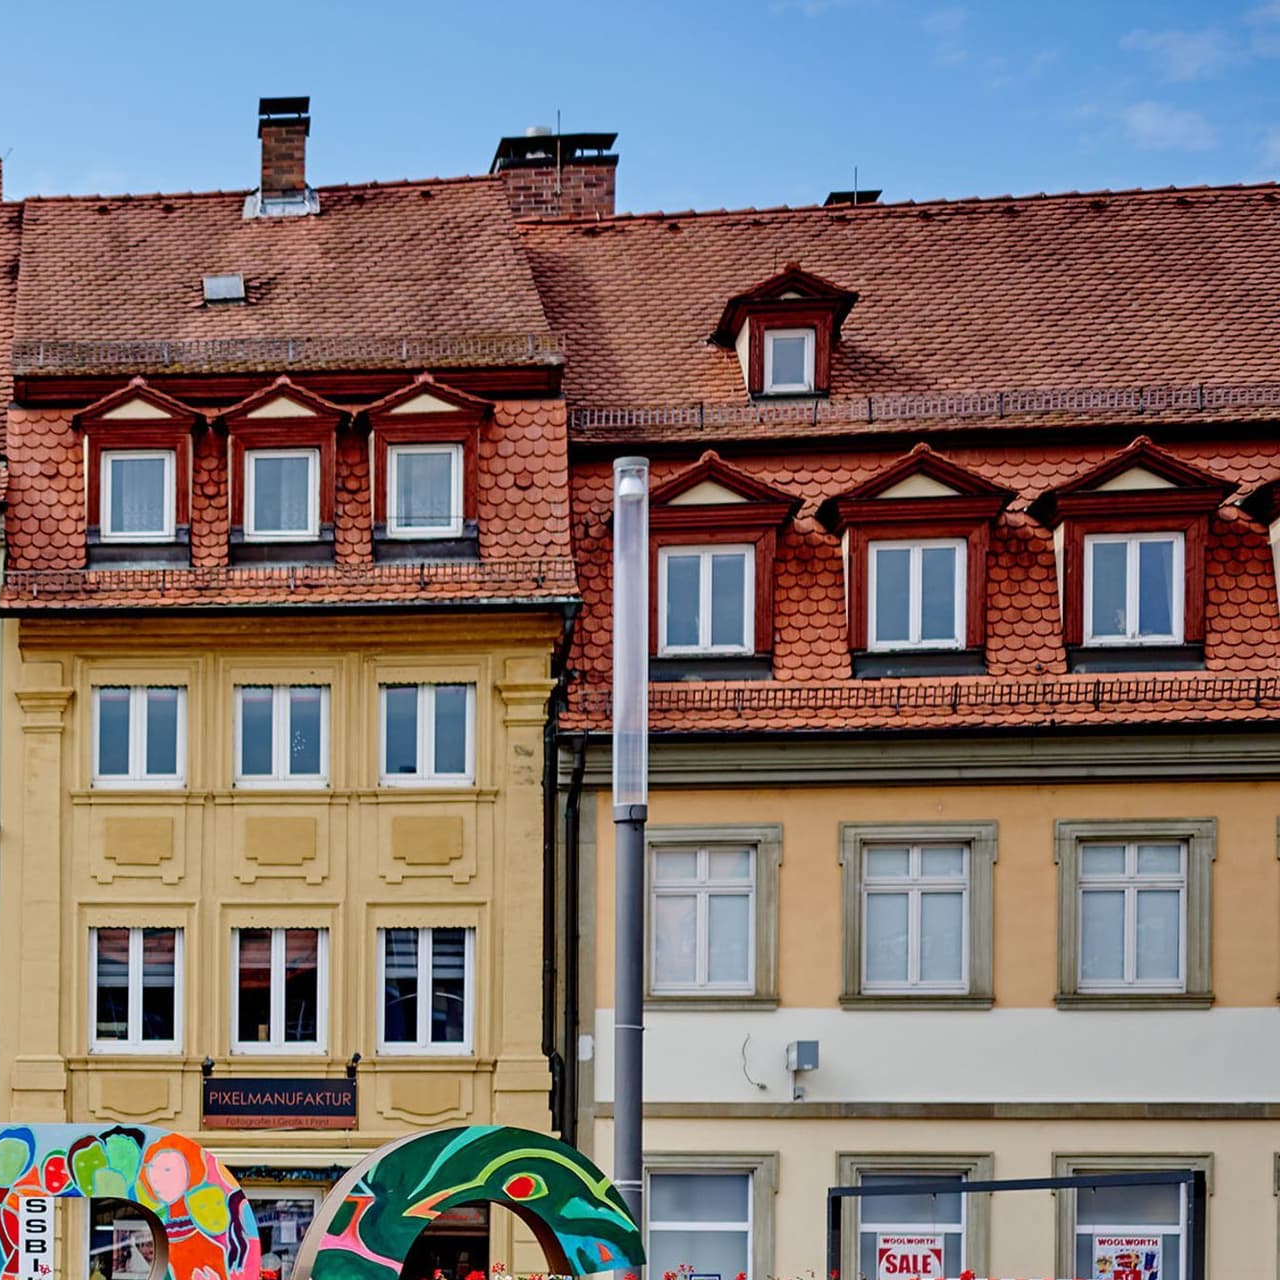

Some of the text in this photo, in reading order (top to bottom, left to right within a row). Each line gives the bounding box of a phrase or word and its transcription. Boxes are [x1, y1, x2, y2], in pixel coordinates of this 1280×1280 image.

[209, 1091, 351, 1106] PIXELMANUFAKTUR
[310, 1117, 330, 1126] Print
[1098, 1238, 1159, 1246] WOOLWORTH
[885, 1253, 932, 1274] SALE
